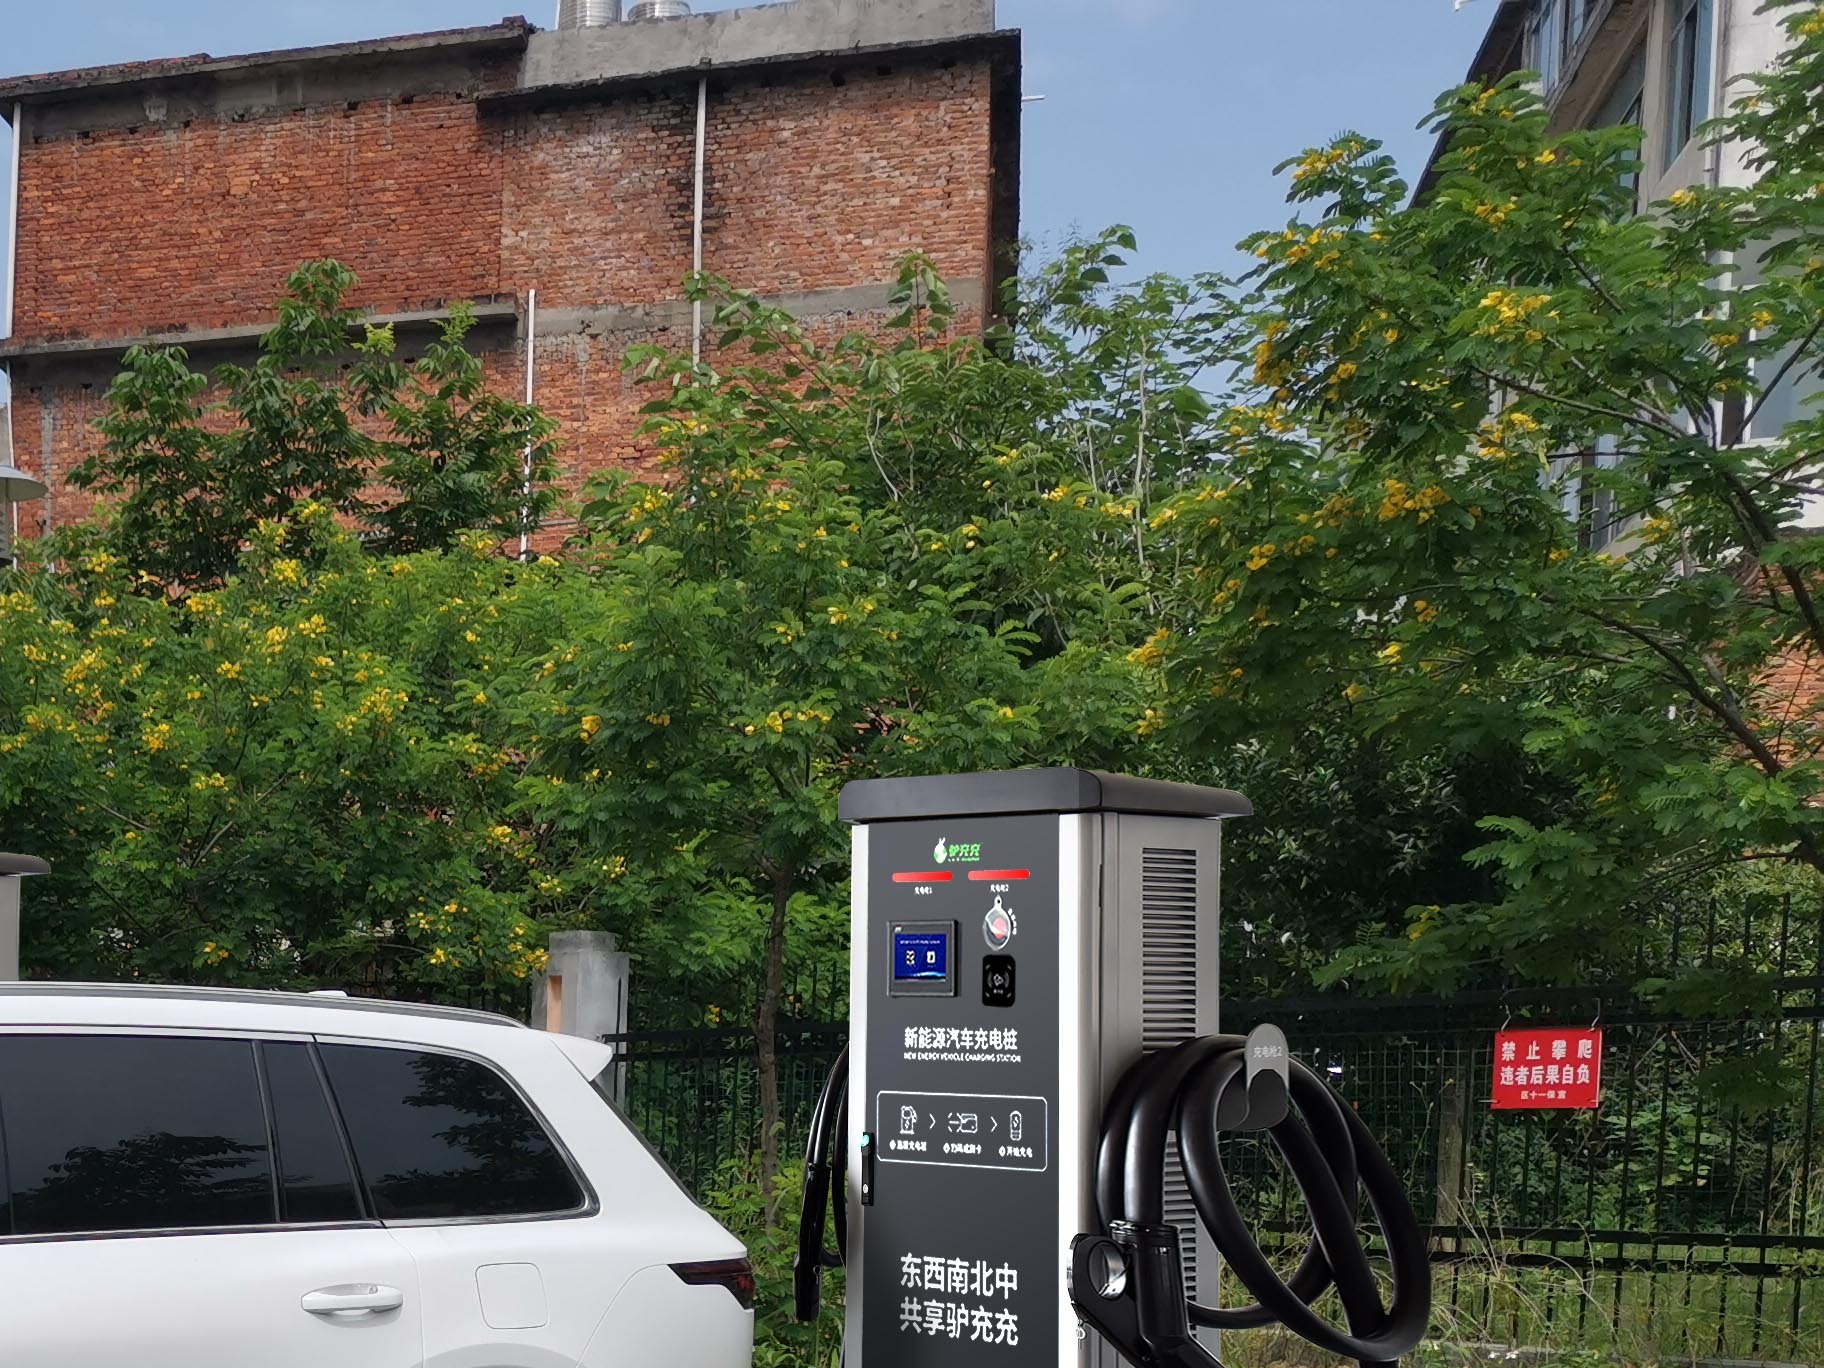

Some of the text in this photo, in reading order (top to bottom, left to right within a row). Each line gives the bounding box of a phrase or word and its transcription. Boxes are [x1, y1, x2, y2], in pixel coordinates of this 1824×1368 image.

[904, 1026, 1018, 1050] 新能源汽车充电桩
[1501, 1039, 1593, 1062] 禁止攀爬
[1500, 1063, 1590, 1086] 违者后果自负
[900, 1252, 1018, 1299] 东西南北中
[899, 1296, 1019, 1346] 共享驴充充
